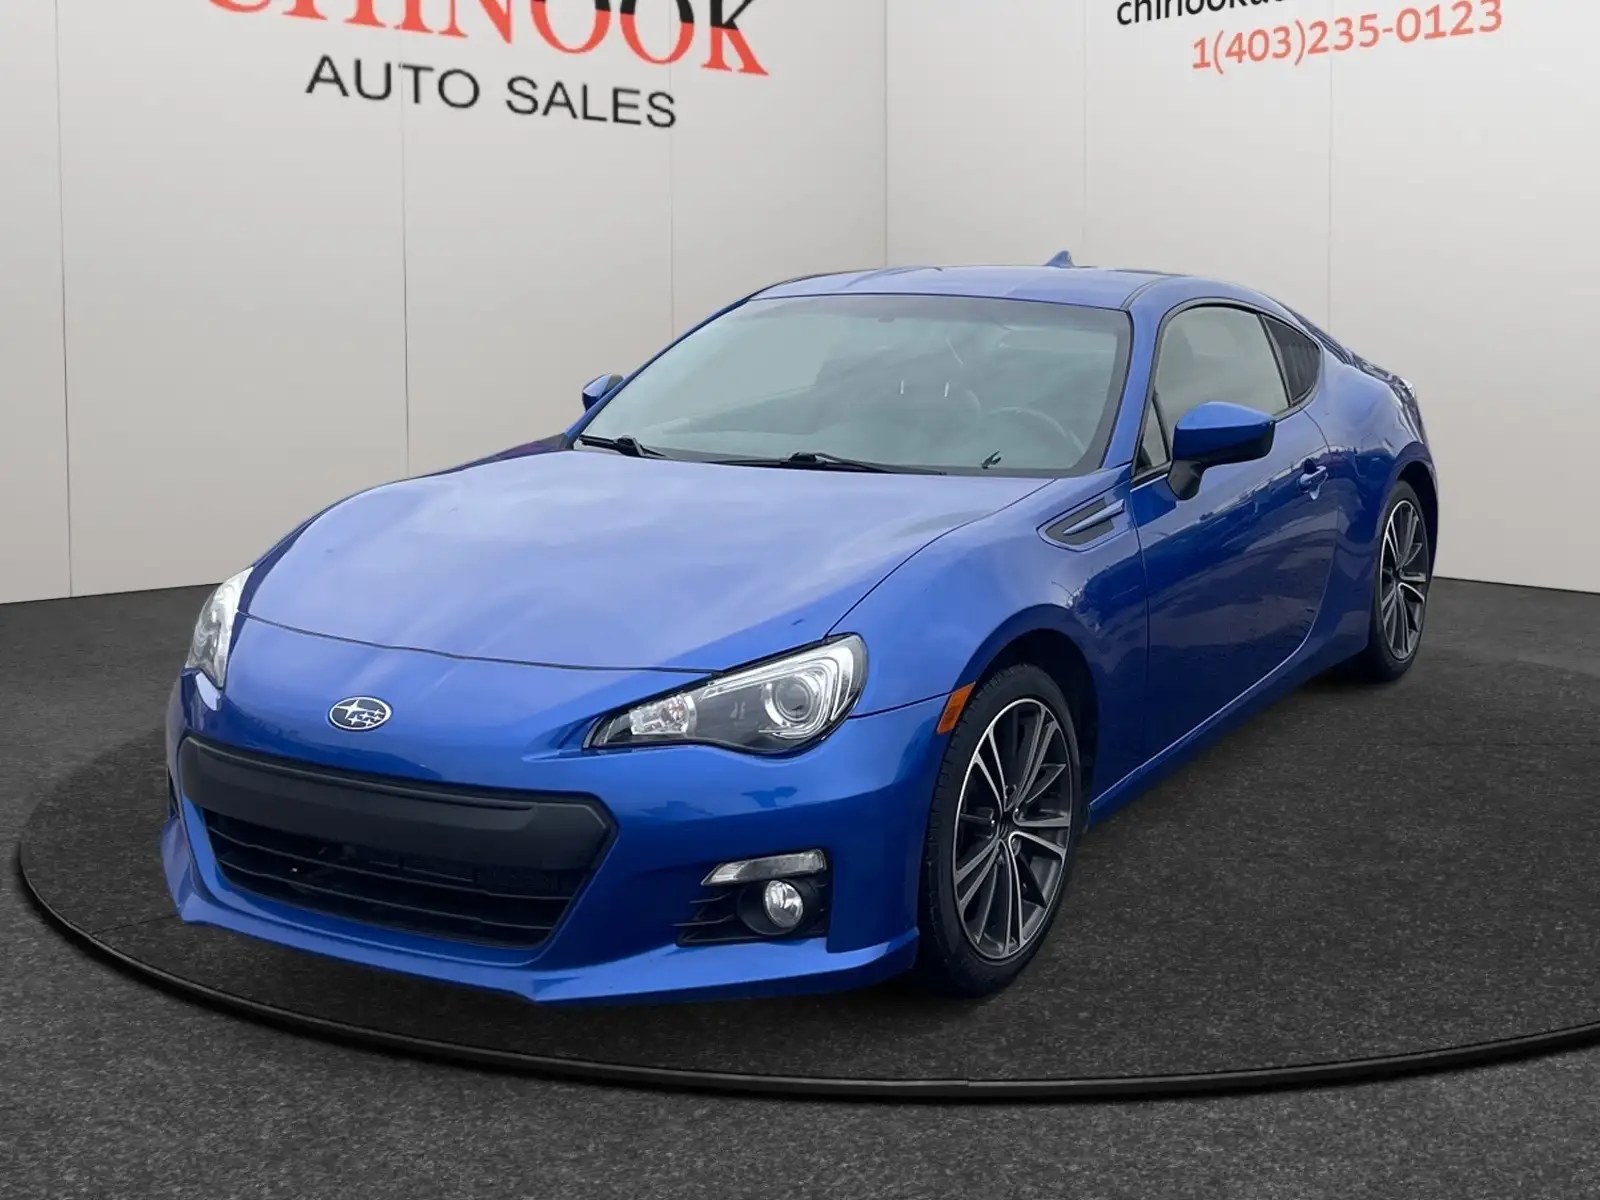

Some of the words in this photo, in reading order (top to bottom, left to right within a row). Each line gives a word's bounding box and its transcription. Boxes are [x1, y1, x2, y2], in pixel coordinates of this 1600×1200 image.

[1192, 0, 1504, 75] 1(403)235-0123
[306, 55, 480, 109] AUTO
[506, 76, 677, 129] SALES
